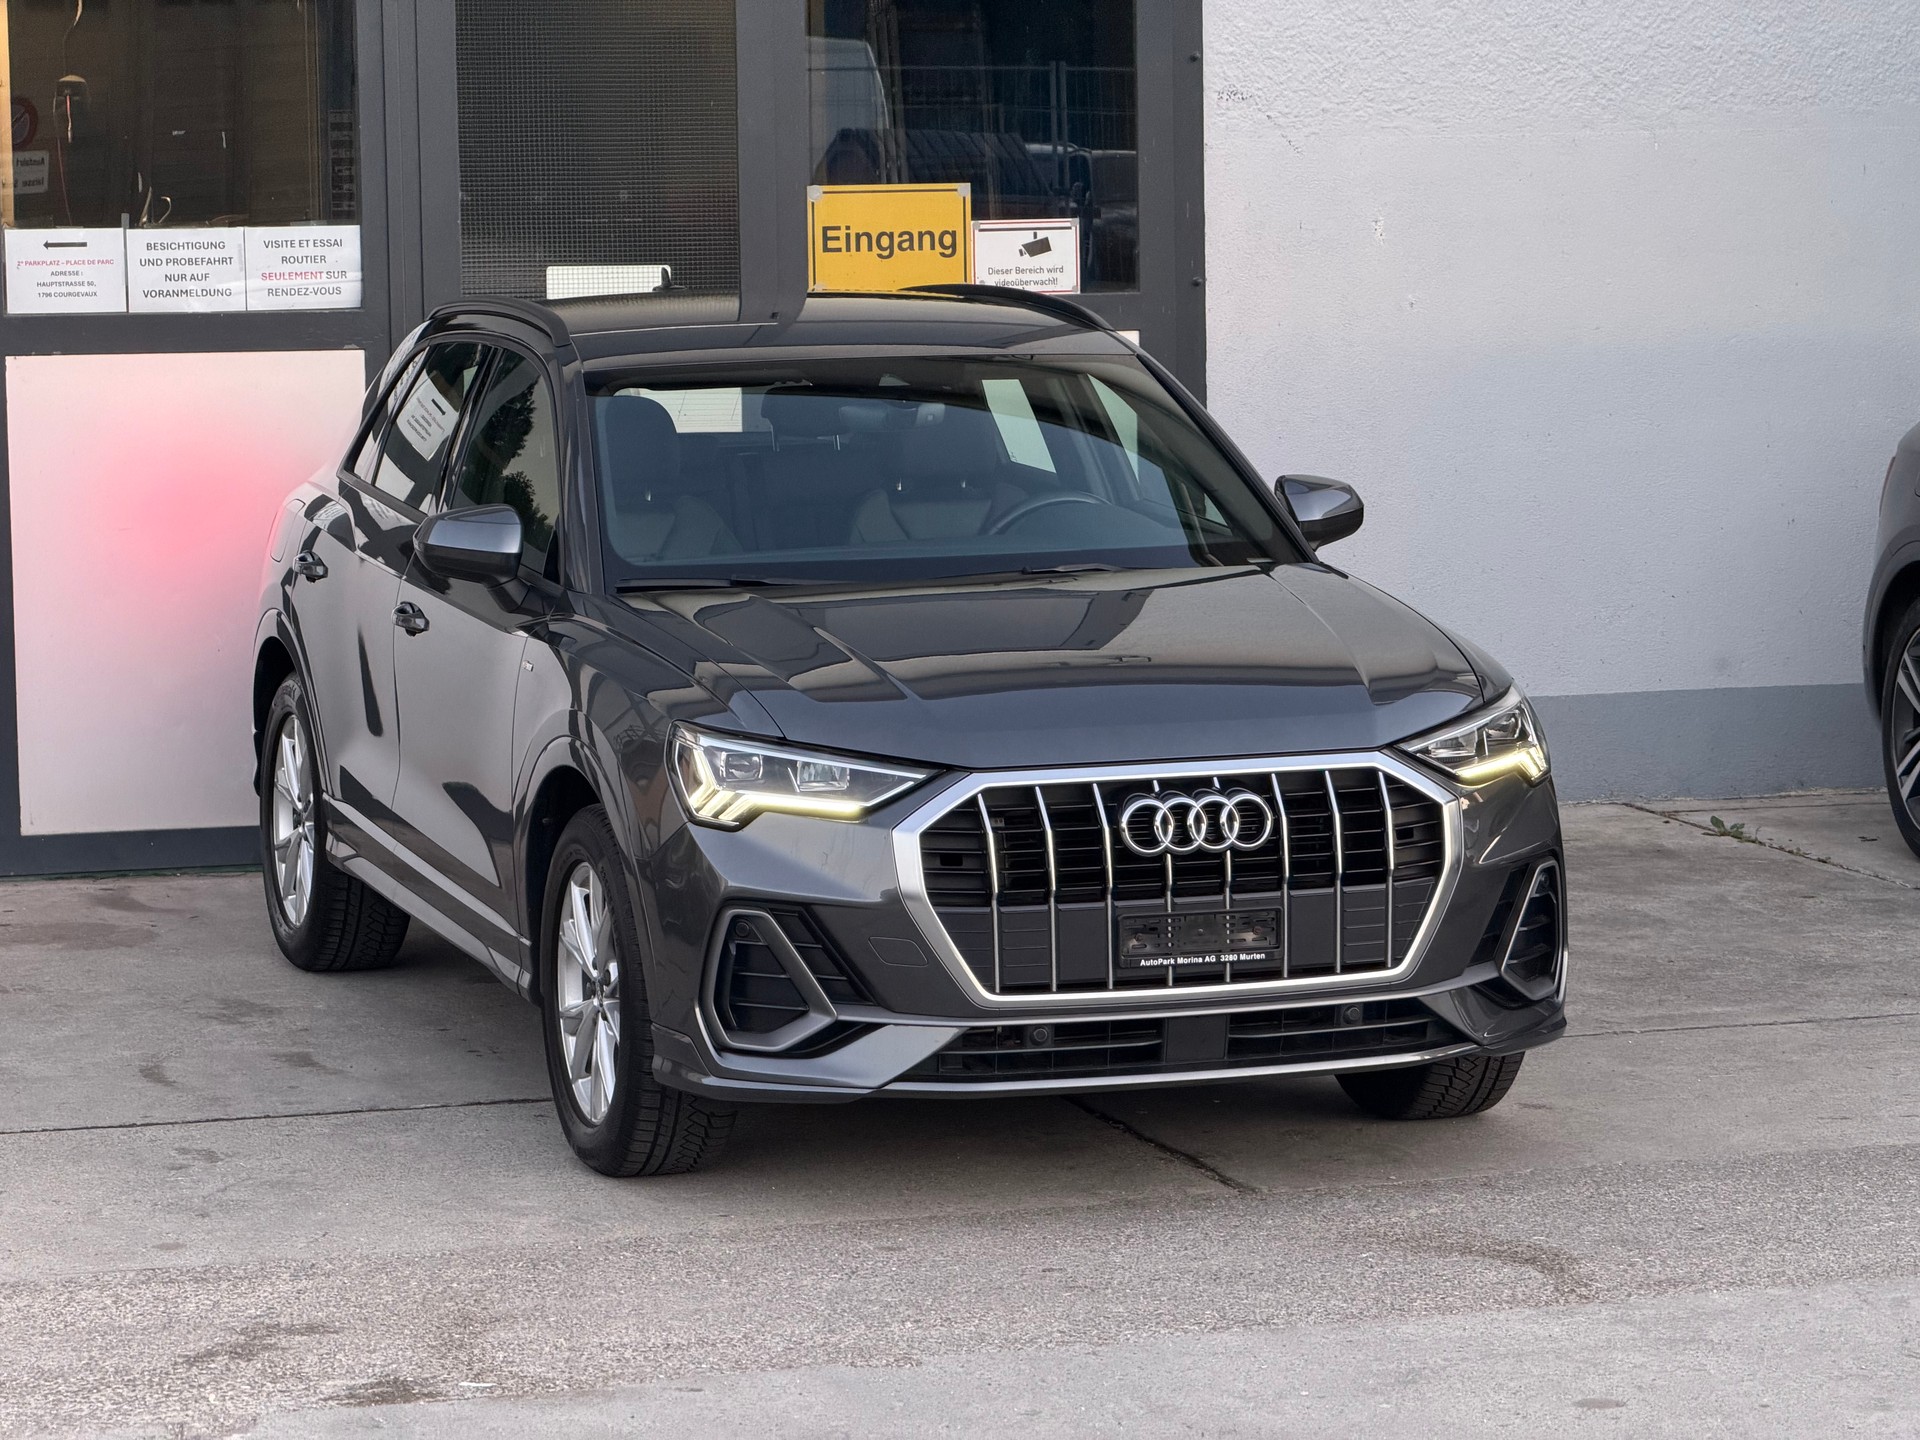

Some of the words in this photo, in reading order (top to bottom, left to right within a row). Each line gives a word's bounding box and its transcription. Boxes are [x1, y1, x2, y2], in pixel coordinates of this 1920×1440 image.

[146, 241, 226, 251] BESICHTIGUNG
[263, 240, 296, 249] VISITE
[298, 239, 311, 248] ET
[312, 239, 343, 248] ESSAI
[822, 225, 957, 259] Eingang
[140, 258, 163, 267] UND
[165, 257, 234, 266] PROBEFAHRT
[281, 255, 327, 264] ROUTIER
[261, 271, 324, 281] SEULEMENT
[325, 270, 348, 279] SUR
[987, 266, 1014, 276] Dieser
[1015, 265, 1045, 275] Bereich
[1046, 265, 1064, 274] wird
[164, 273, 188, 282] NUR
[189, 273, 210, 282] AUF
[143, 288, 232, 298] VORANMELDUNG
[267, 286, 342, 297] RENDEZ-VOUS
[1140, 957, 1175, 967] AutoPark
[1176, 956, 1203, 965] Morina
[1204, 955, 1216, 963] AG
[1239, 953, 1266, 961] Murten
